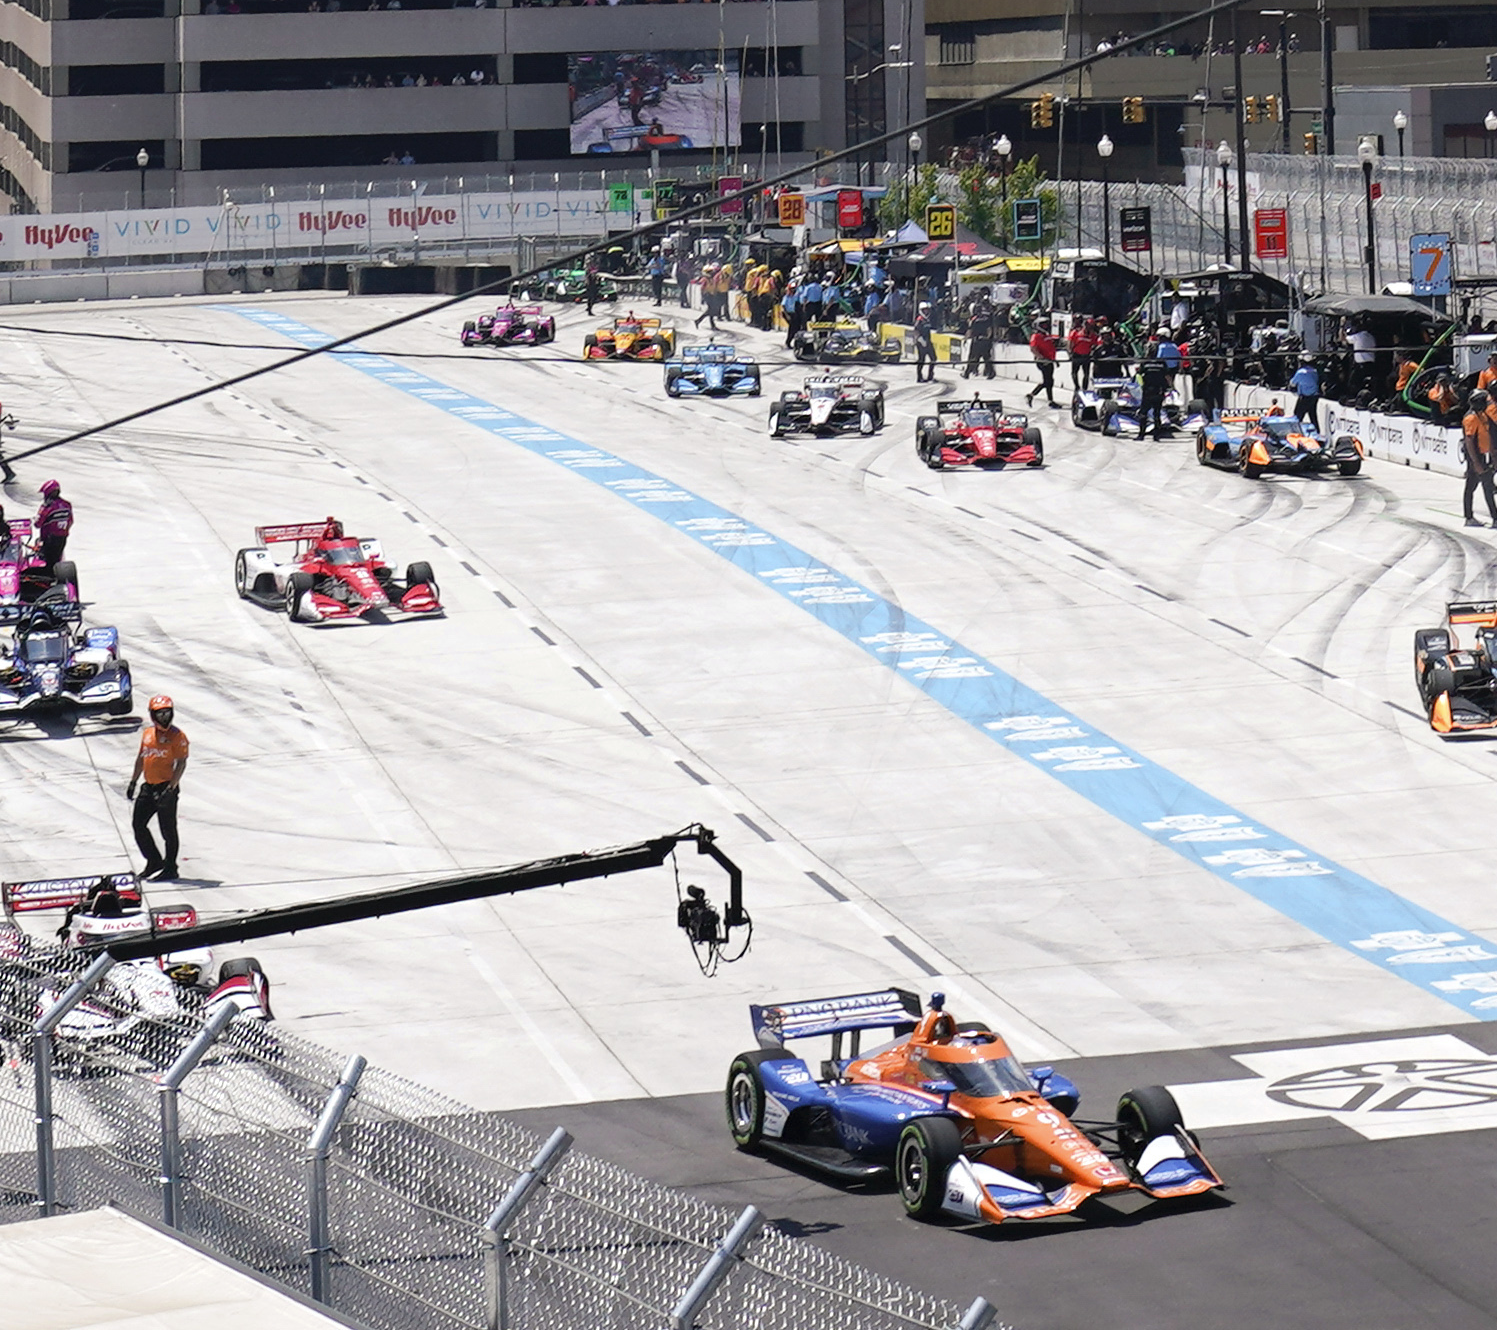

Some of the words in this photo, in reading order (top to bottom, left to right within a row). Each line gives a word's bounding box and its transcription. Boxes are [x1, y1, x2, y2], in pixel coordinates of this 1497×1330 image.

[115, 218, 191, 237] VIVID
[206, 214, 282, 232] VVID
[930, 212, 953, 235] 26
[1419, 248, 1444, 282] 7
[837, 994, 894, 1013] BANK
